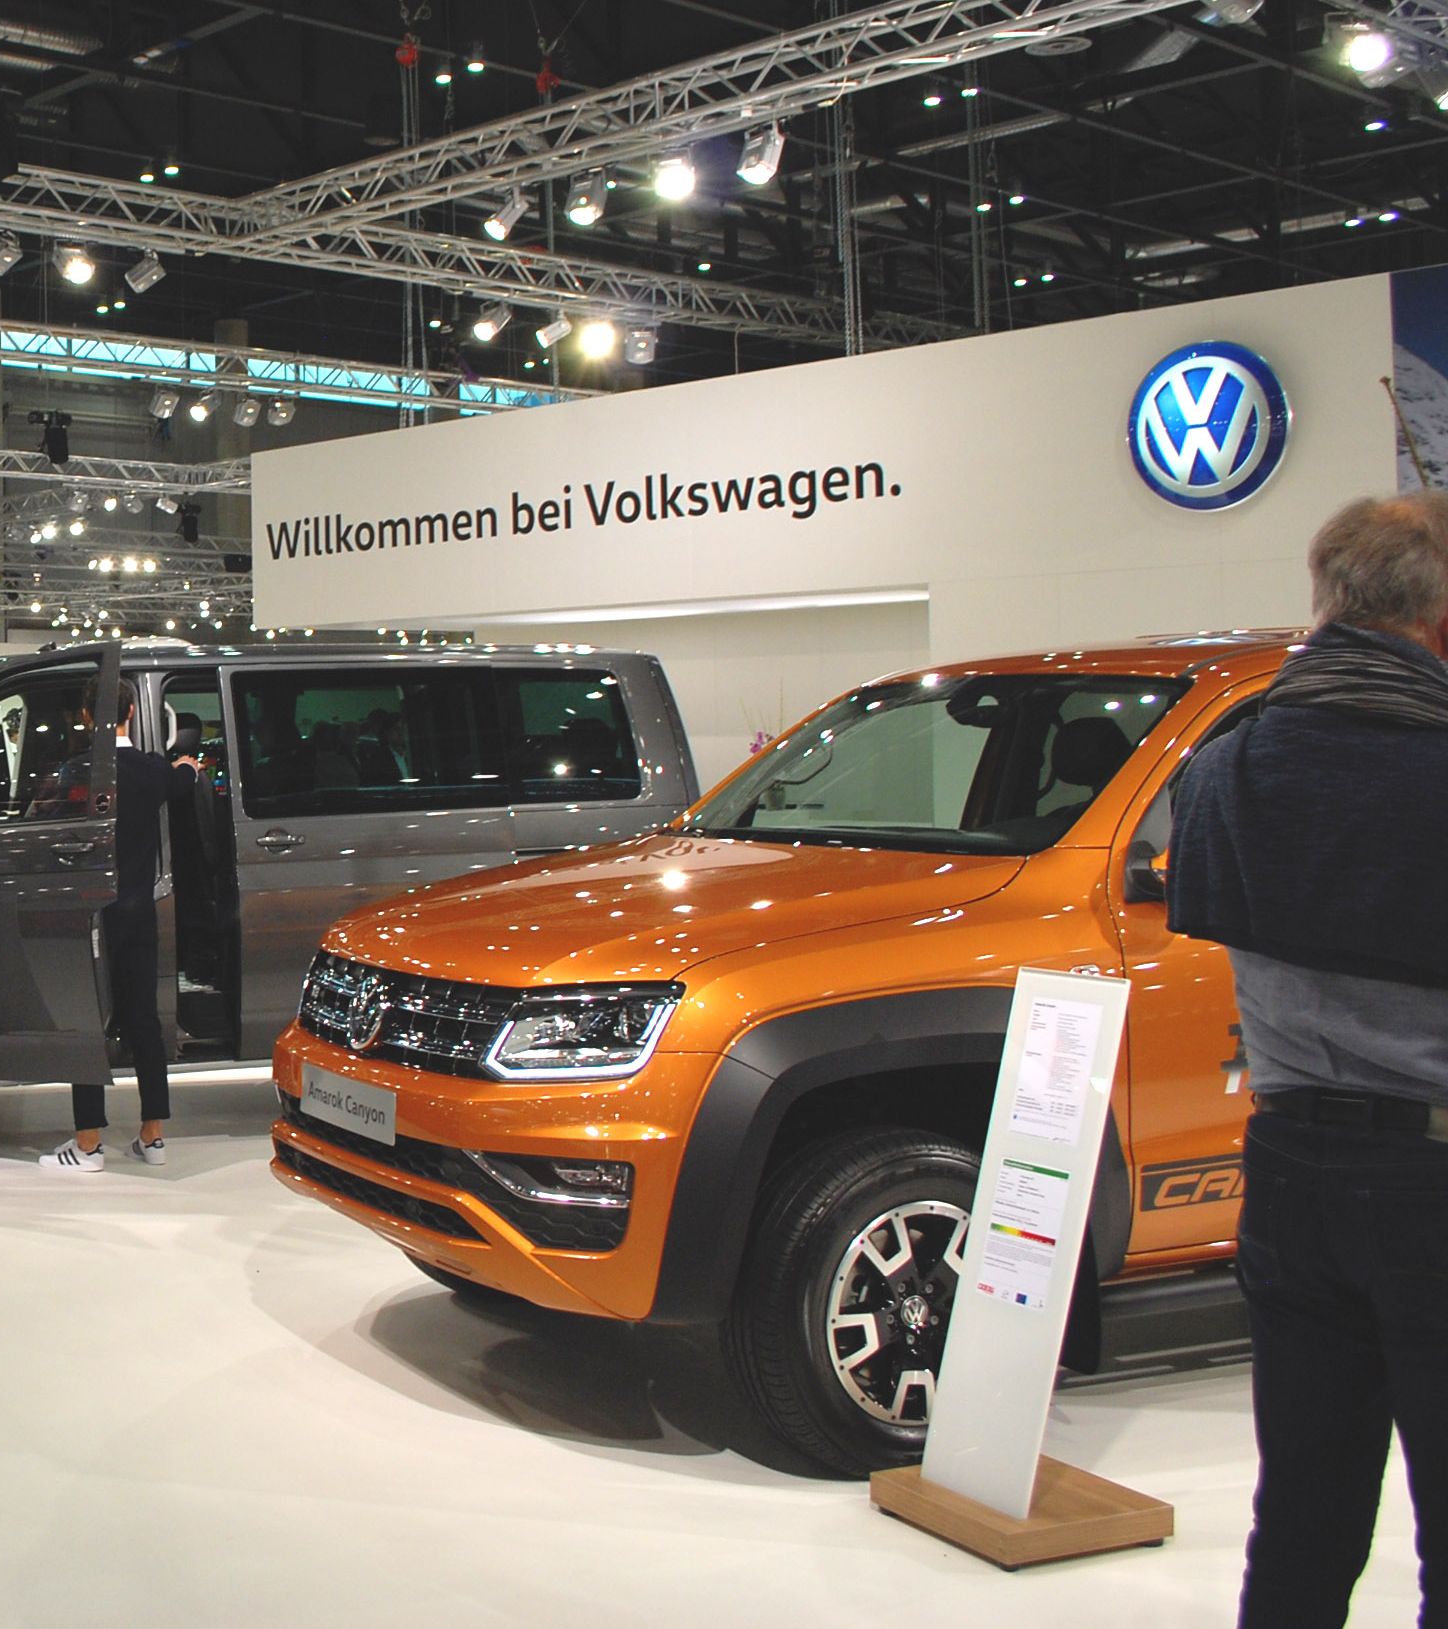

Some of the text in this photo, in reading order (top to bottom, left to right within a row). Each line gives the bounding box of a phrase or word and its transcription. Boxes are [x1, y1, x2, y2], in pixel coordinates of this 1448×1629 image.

[265, 461, 902, 560] Willkommen bei Volkswagen.
[307, 1081, 386, 1125] Amarok Canyon
[1154, 1168, 1245, 1208] CA
